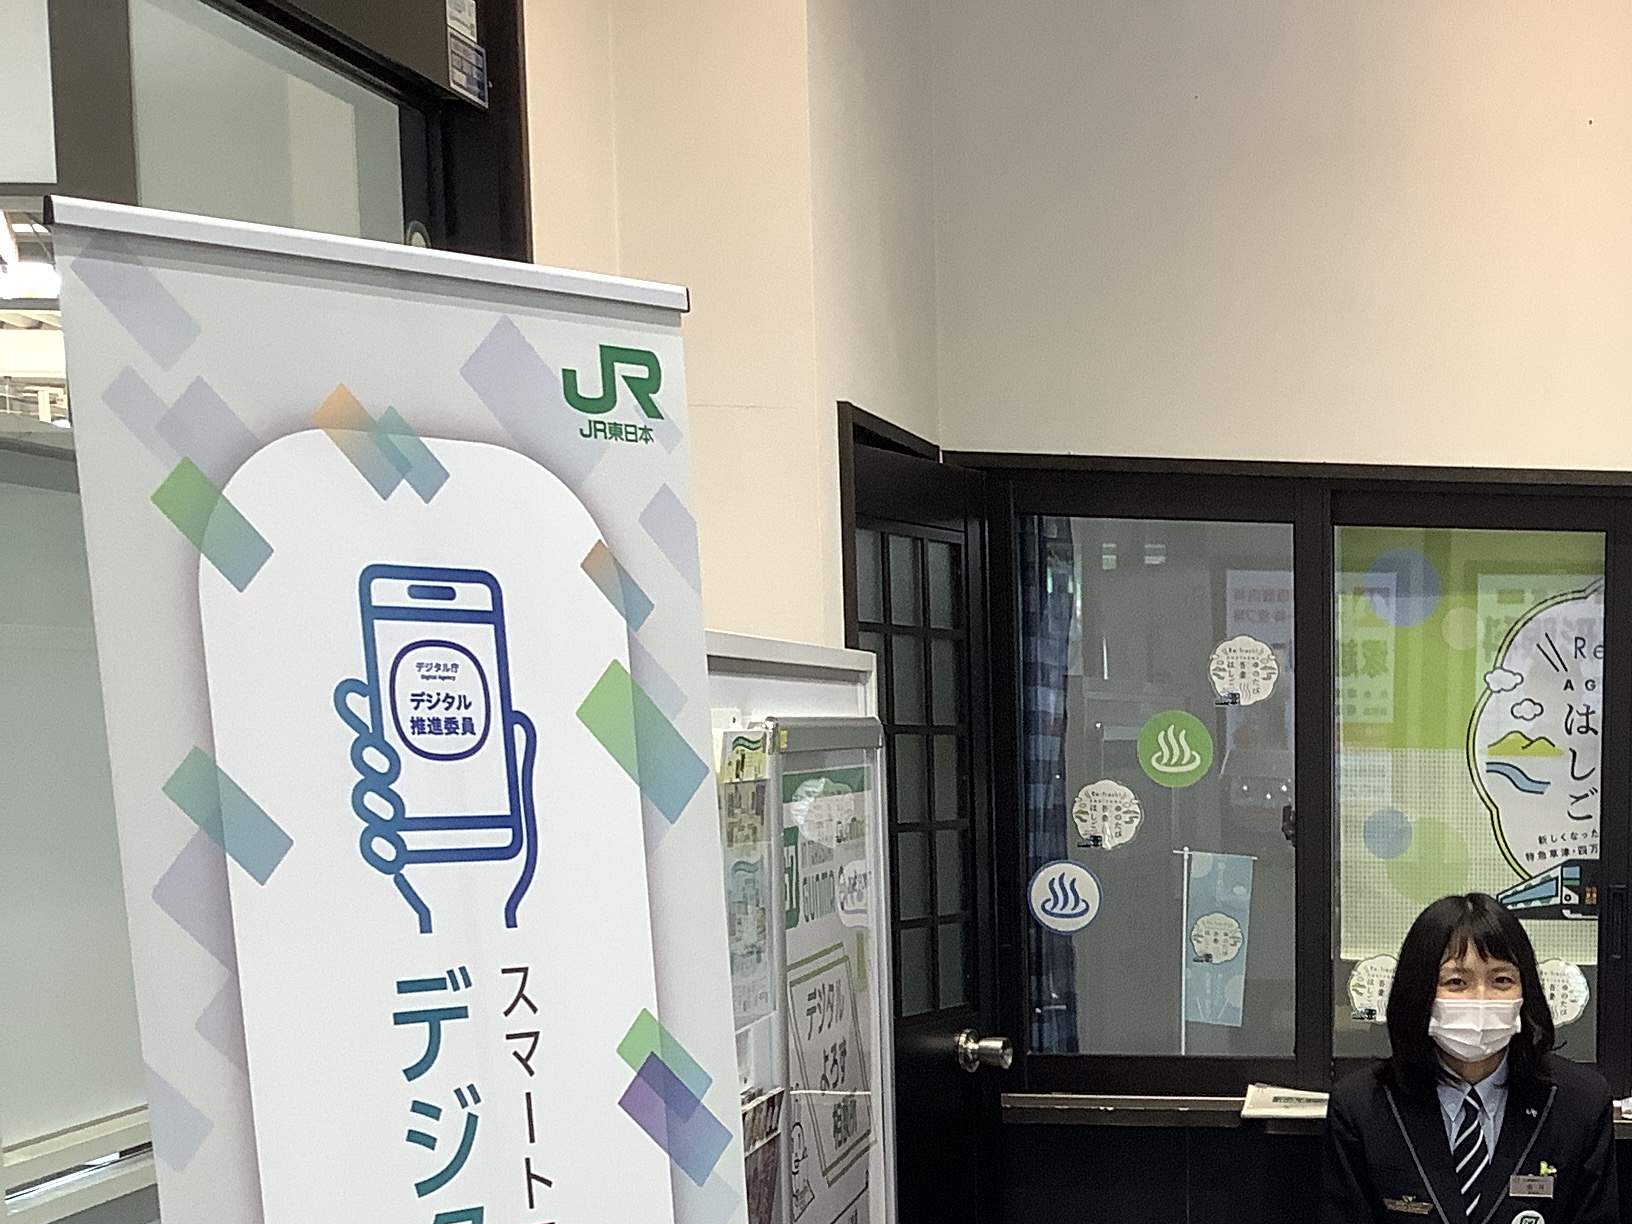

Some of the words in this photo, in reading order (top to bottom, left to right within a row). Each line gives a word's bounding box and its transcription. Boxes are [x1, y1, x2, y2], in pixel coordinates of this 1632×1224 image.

[562, 344, 664, 420] JR
[579, 420, 654, 444] JR東日本
[416, 662, 459, 673] デジタル庁
[410, 692, 472, 710] デジタル
[410, 717, 476, 735] 推進委員
[1564, 703, 1599, 821] はしご
